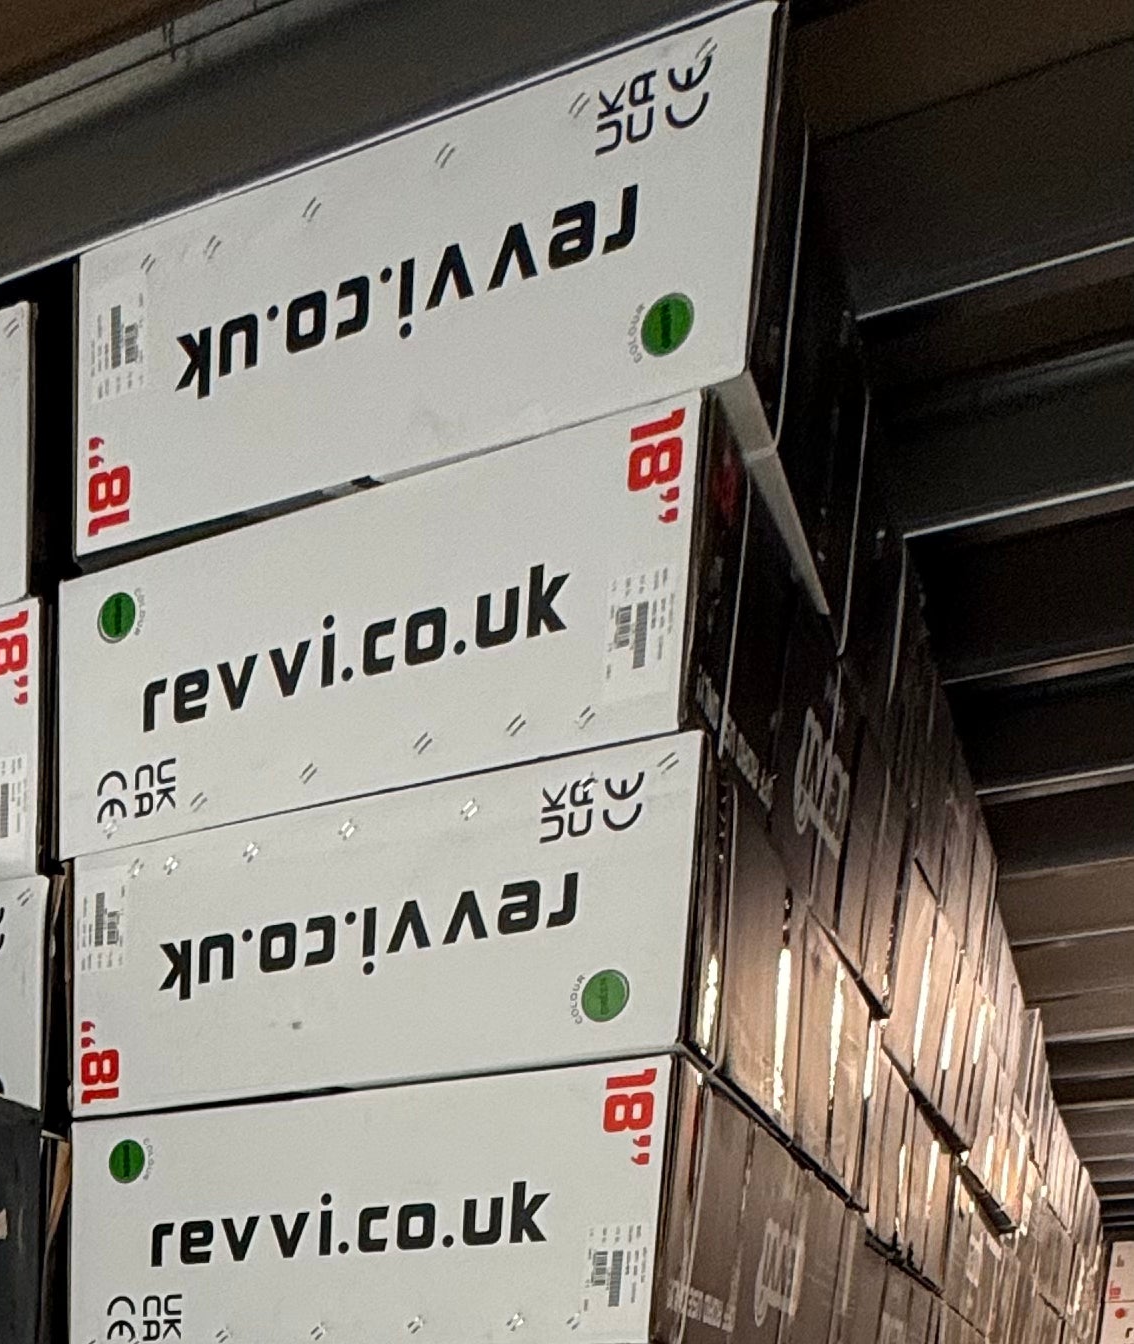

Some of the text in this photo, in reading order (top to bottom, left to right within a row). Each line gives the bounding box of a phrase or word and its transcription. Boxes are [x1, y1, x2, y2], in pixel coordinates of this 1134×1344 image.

[175, 185, 638, 399] revvi.co.uk
[144, 564, 569, 734] revvi.co.uk
[159, 872, 578, 1000] revvi.co.uk
[152, 1181, 549, 1267] revvi.co.uk
